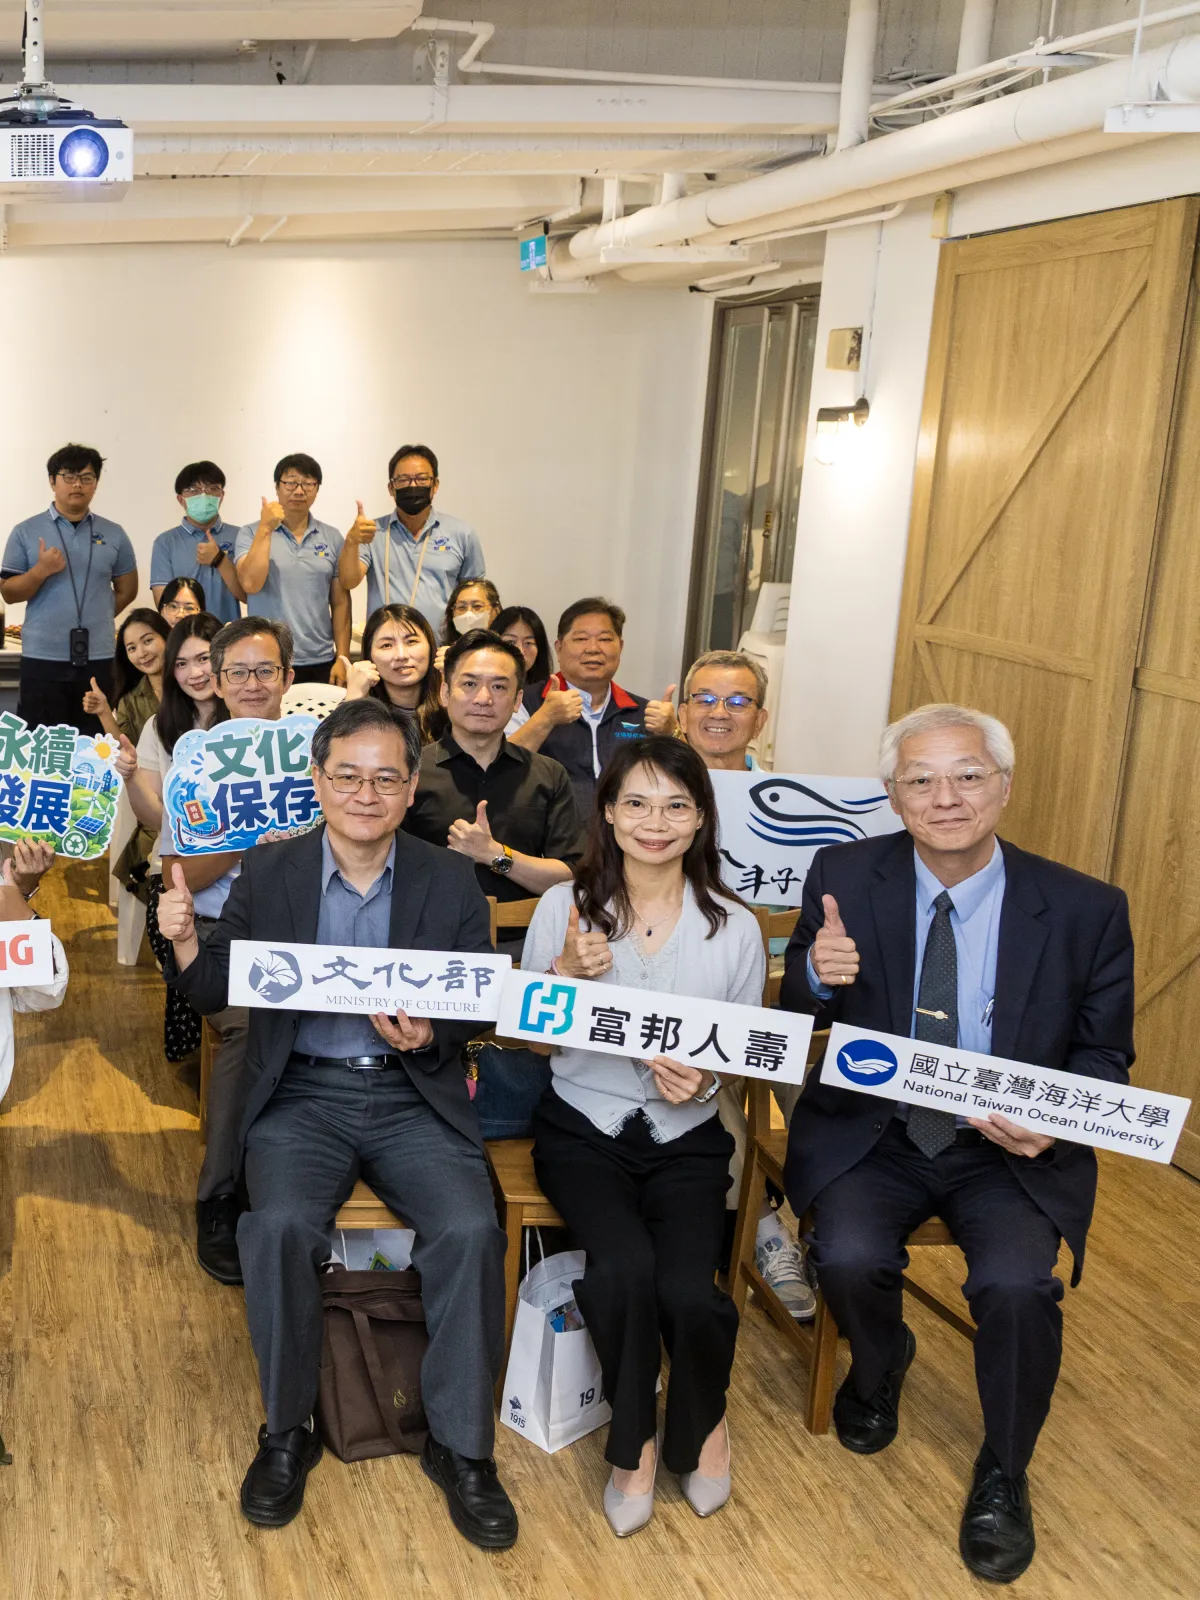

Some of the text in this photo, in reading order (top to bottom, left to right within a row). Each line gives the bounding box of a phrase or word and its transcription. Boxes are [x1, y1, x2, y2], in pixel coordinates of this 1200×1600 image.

[205, 728, 309, 782] 文化
[211, 776, 321, 831] 保存
[311, 955, 495, 998] 文化部
[326, 994, 480, 1013] MINISTRY OF CULTURE
[589, 1006, 789, 1072] 富邦人壽
[903, 1079, 1165, 1150] National Taiwan Ocean University
[909, 1053, 1171, 1129] 國立臺灣海洋大學
[509, 1412, 527, 1429] 1915
[579, 1388, 595, 1407] 19
